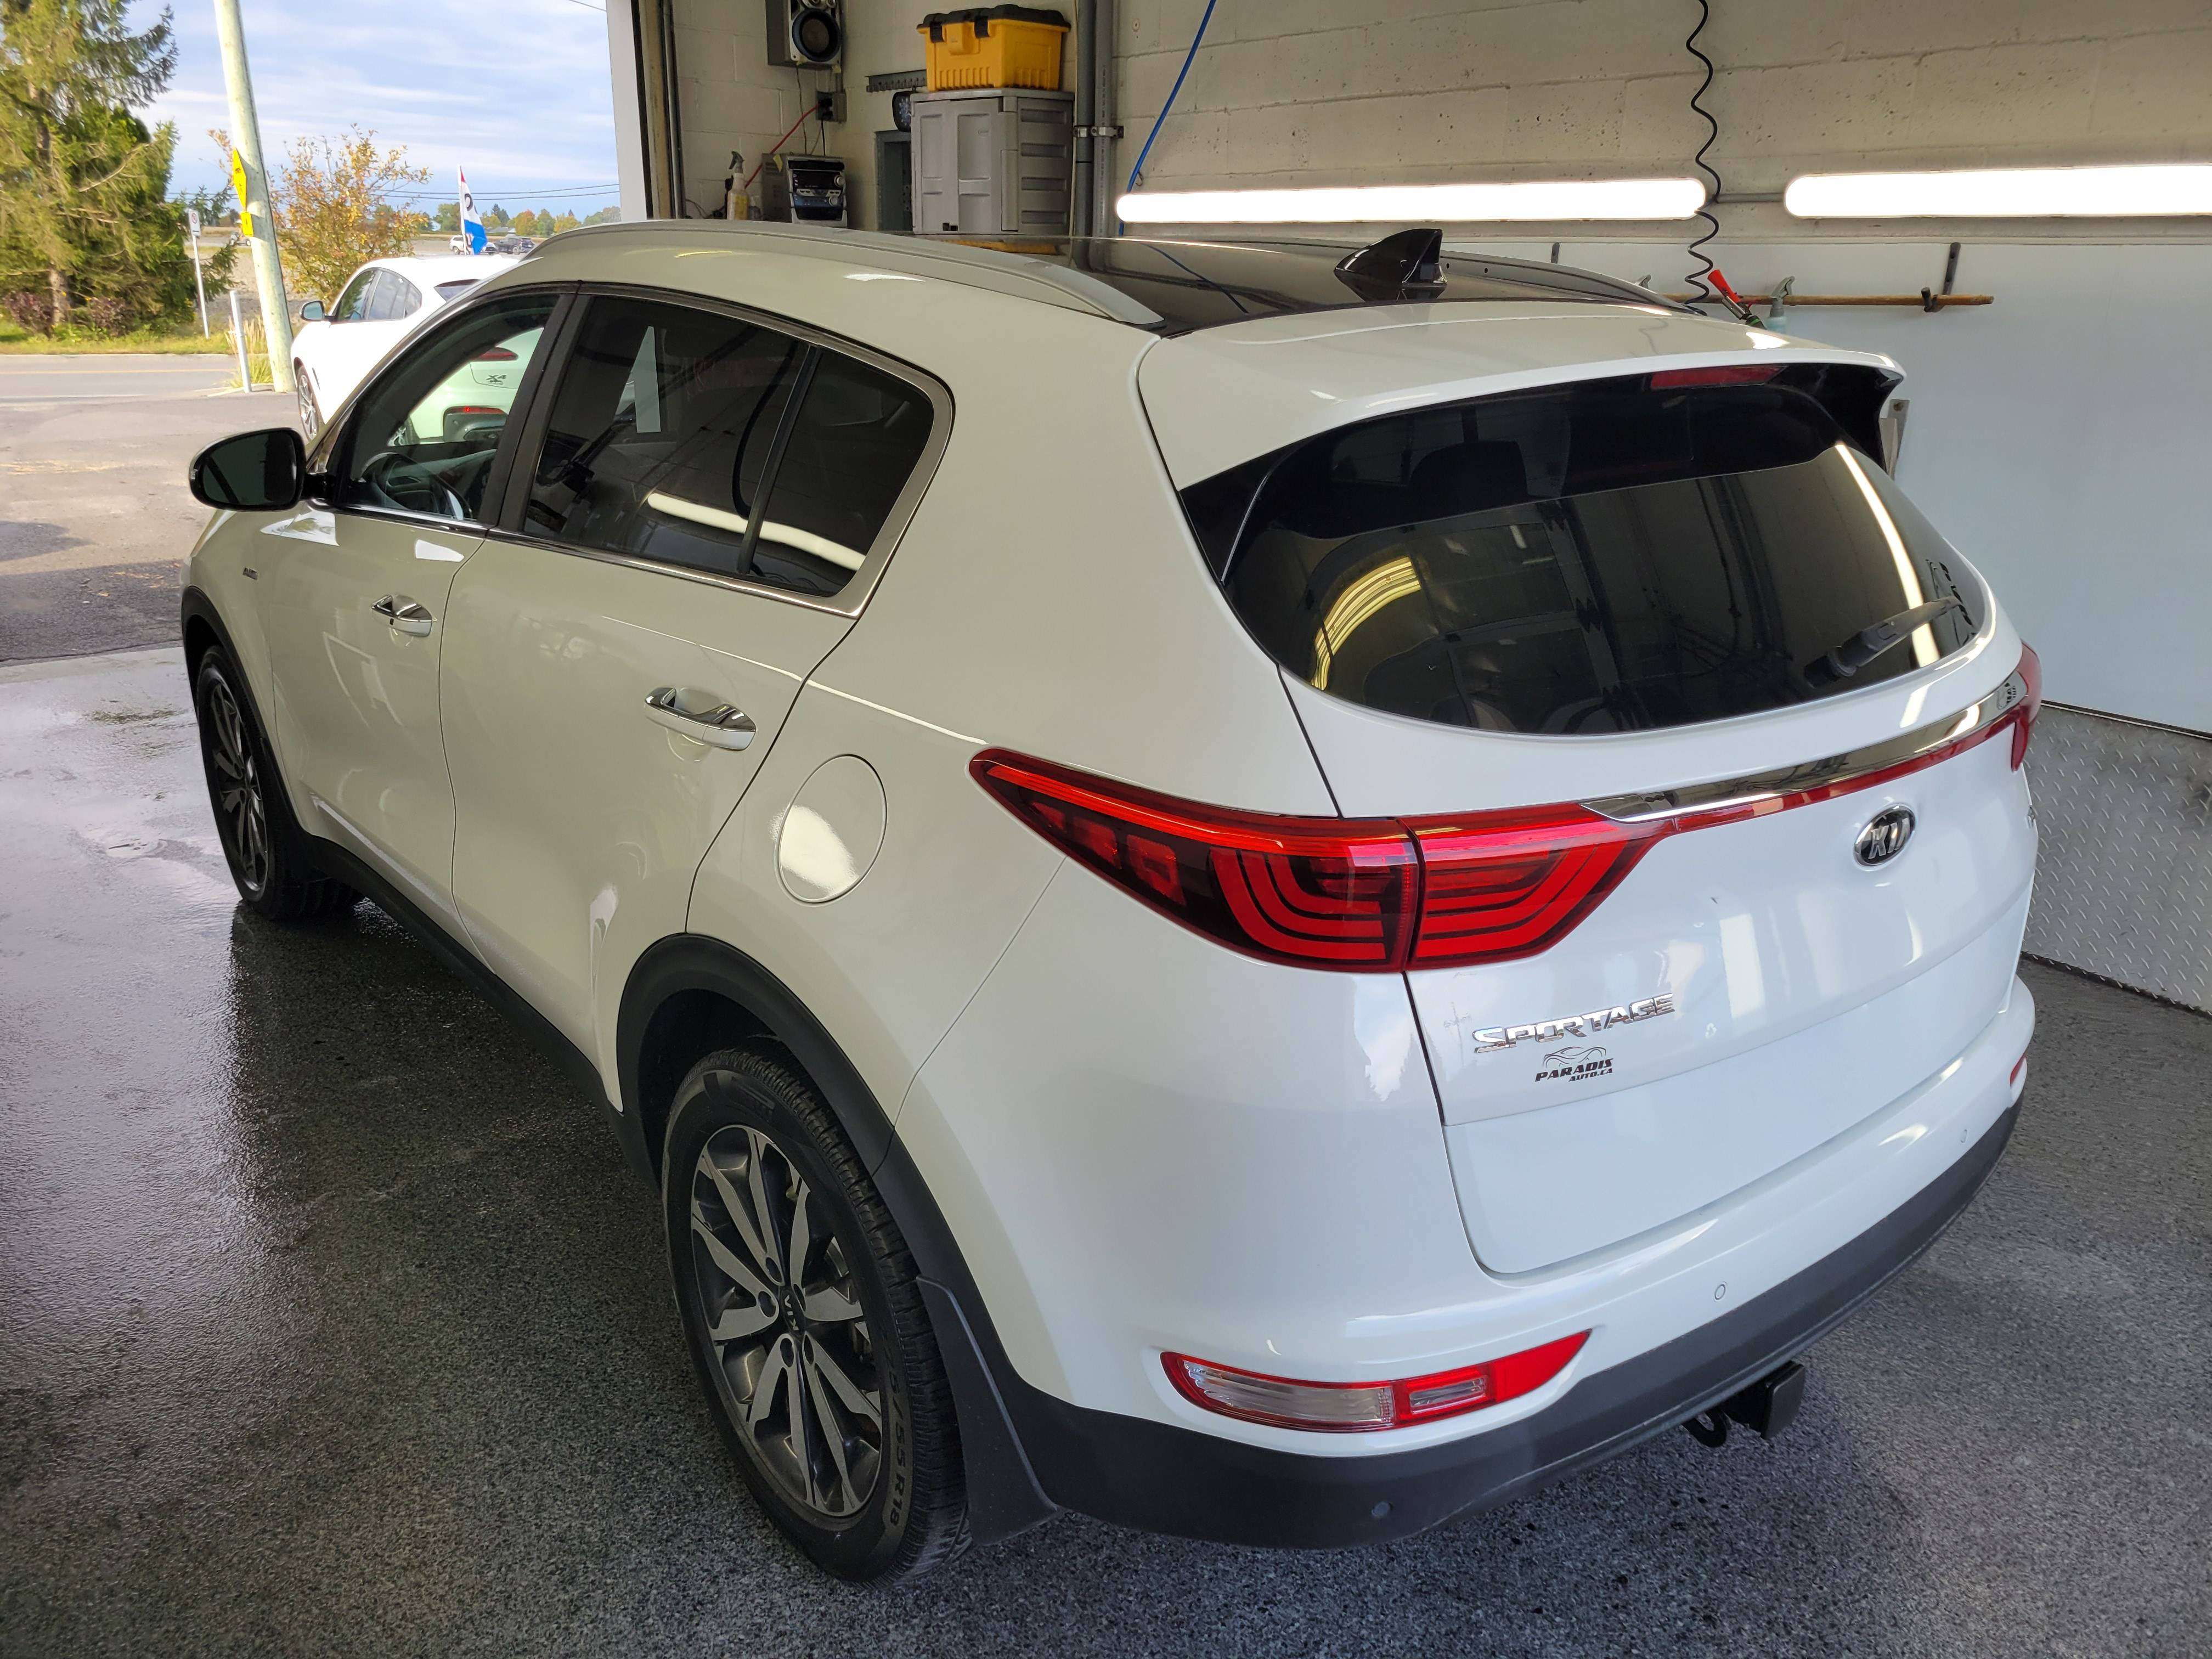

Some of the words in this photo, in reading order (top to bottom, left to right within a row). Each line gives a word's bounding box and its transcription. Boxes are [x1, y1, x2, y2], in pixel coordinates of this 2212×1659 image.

[1868, 817, 1911, 859] KIA
[1472, 992, 1675, 1053] SPORTAGE
[1534, 1058, 1614, 1082] PARADIS
[1568, 1068, 1613, 1082] AUTO.CA
[785, 1294, 800, 1331] KIA
